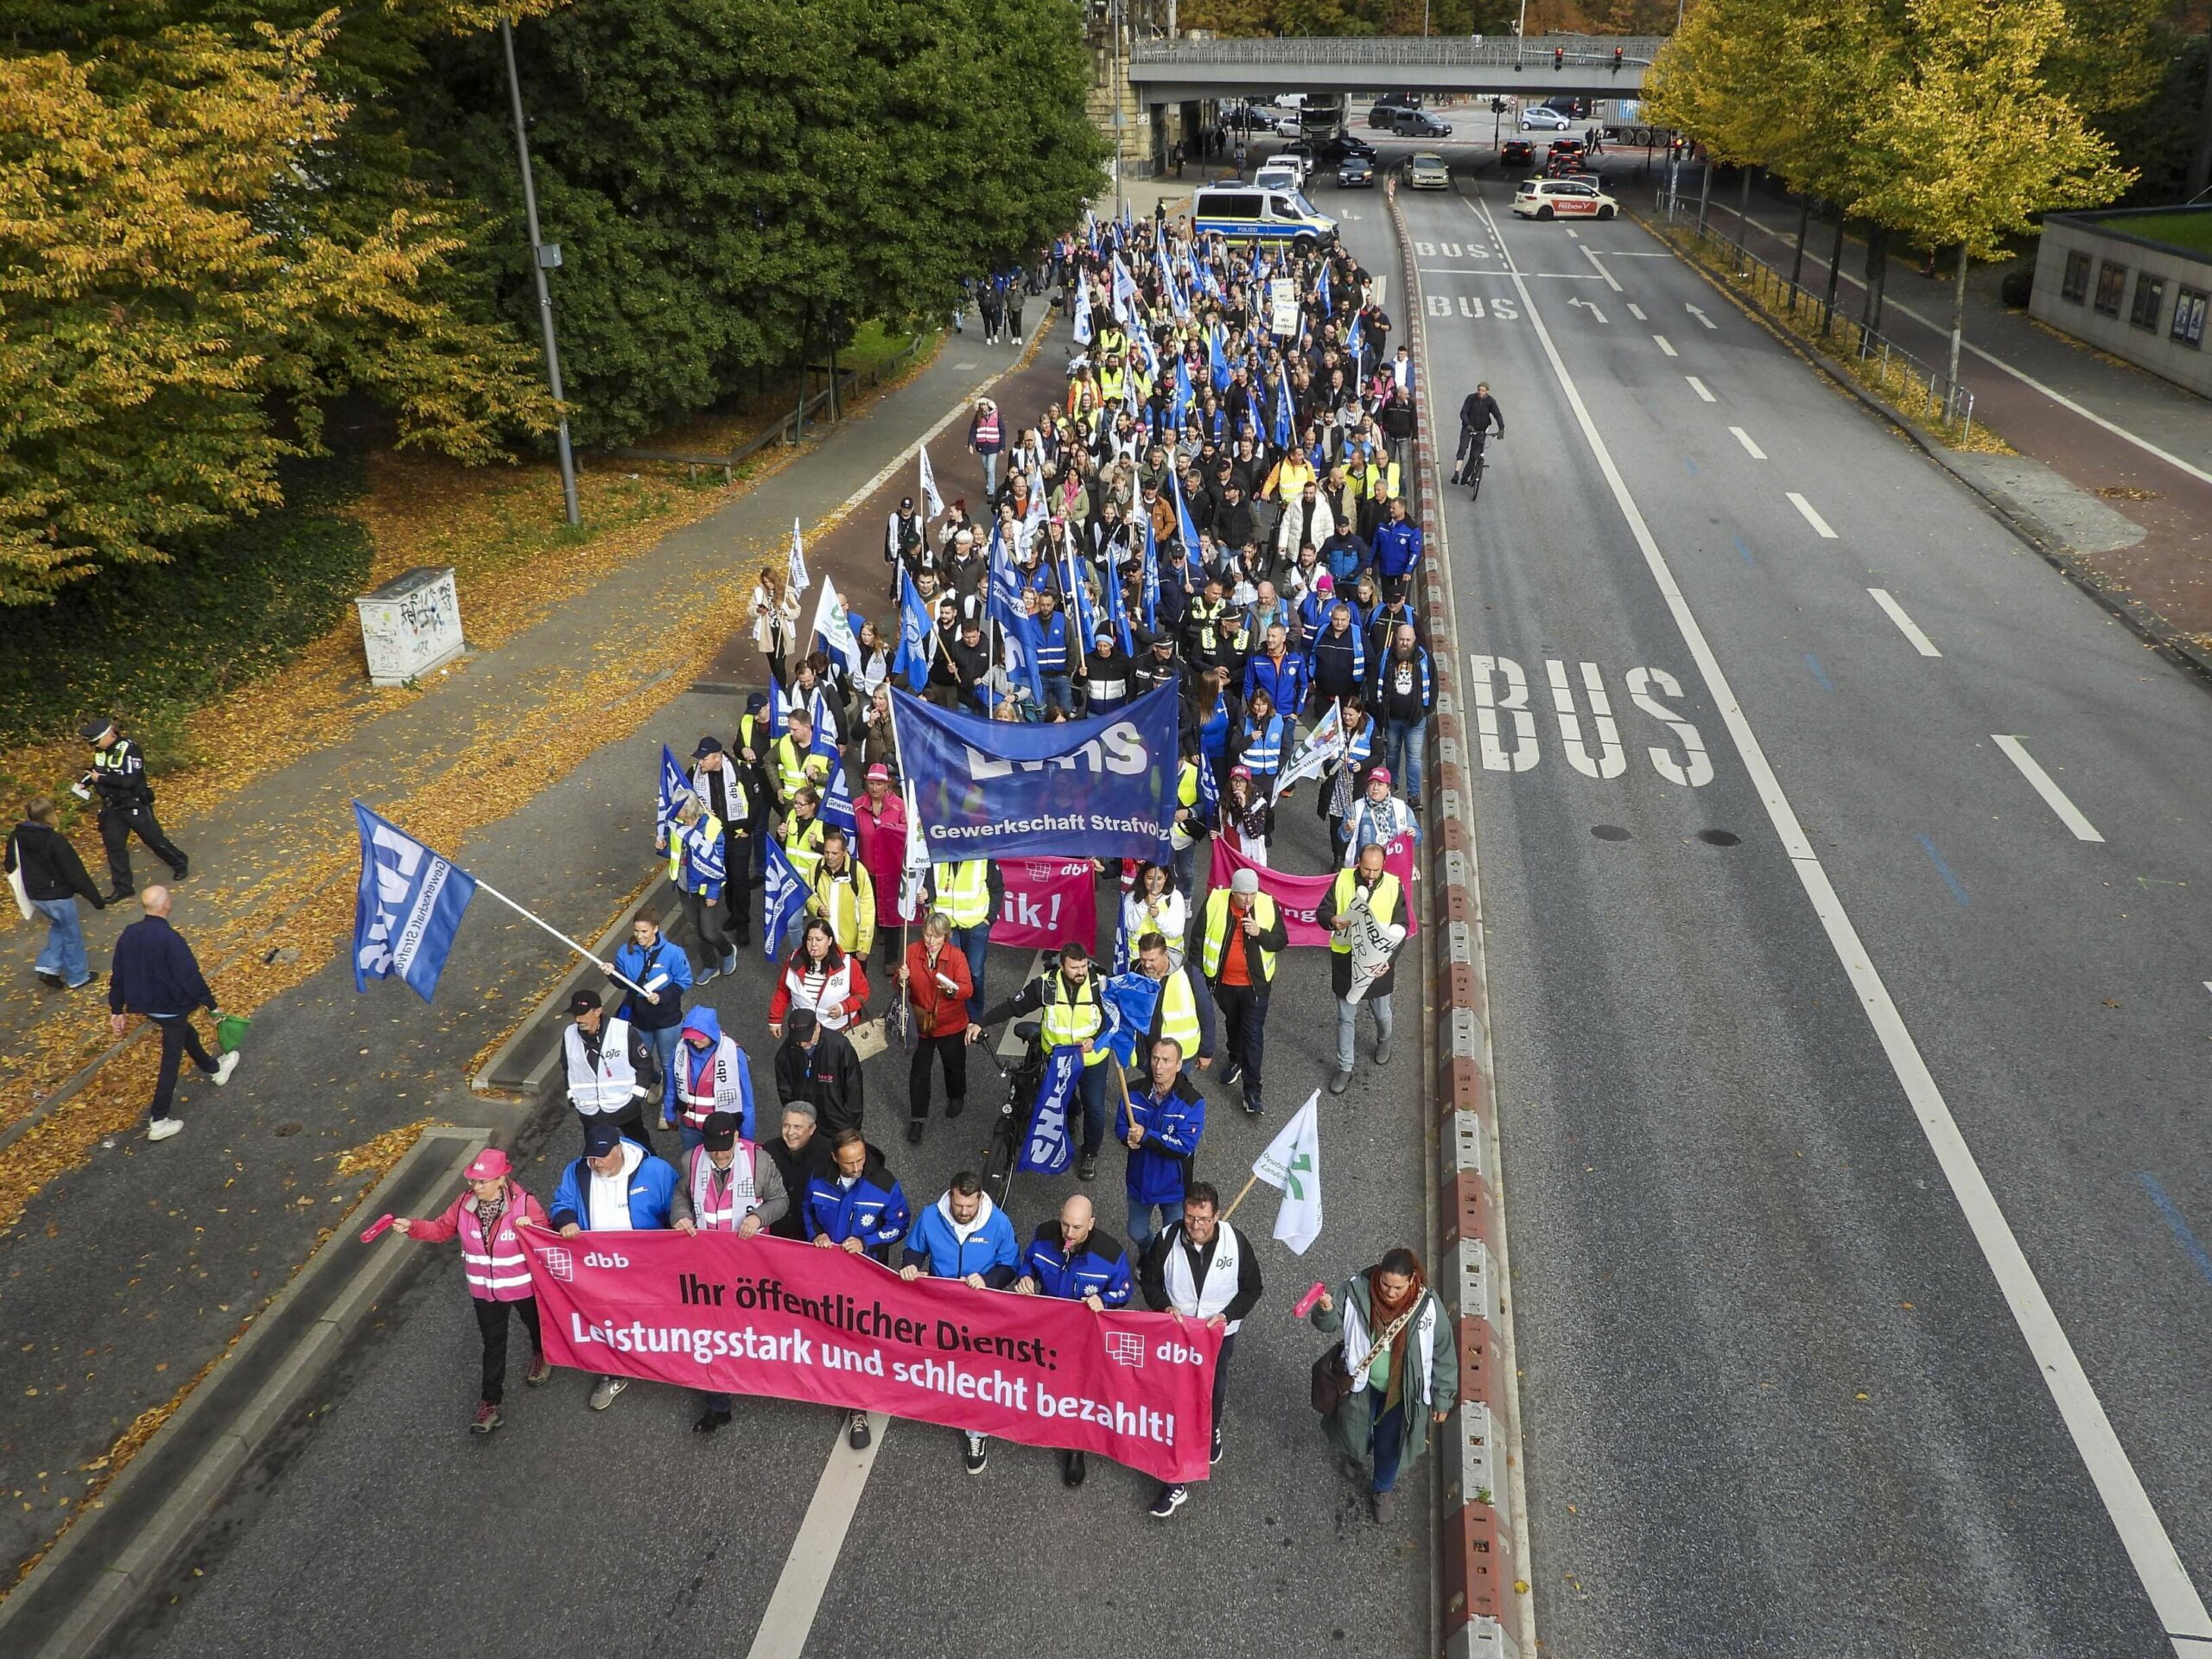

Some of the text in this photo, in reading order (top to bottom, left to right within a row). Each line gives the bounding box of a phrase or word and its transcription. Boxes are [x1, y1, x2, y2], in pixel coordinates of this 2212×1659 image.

[1414, 242, 1490, 258] BUS
[1426, 295, 1519, 320] BUS
[1470, 654, 1714, 787] BUS
[930, 814, 1085, 840] Gewerkschaft
[1002, 891, 1061, 931] ik!
[830, 976, 843, 988] DJG
[605, 1048, 620, 1059] DJG
[499, 1230, 517, 1242] db
[583, 1252, 630, 1268] dbb
[1216, 1255, 1233, 1270] DJG
[678, 1273, 1058, 1371] Ihr öffentlicher Dienst:
[1156, 1341, 1204, 1366] dbb
[570, 1313, 1175, 1446] Leistungsstark und schlecht bezahlt!
